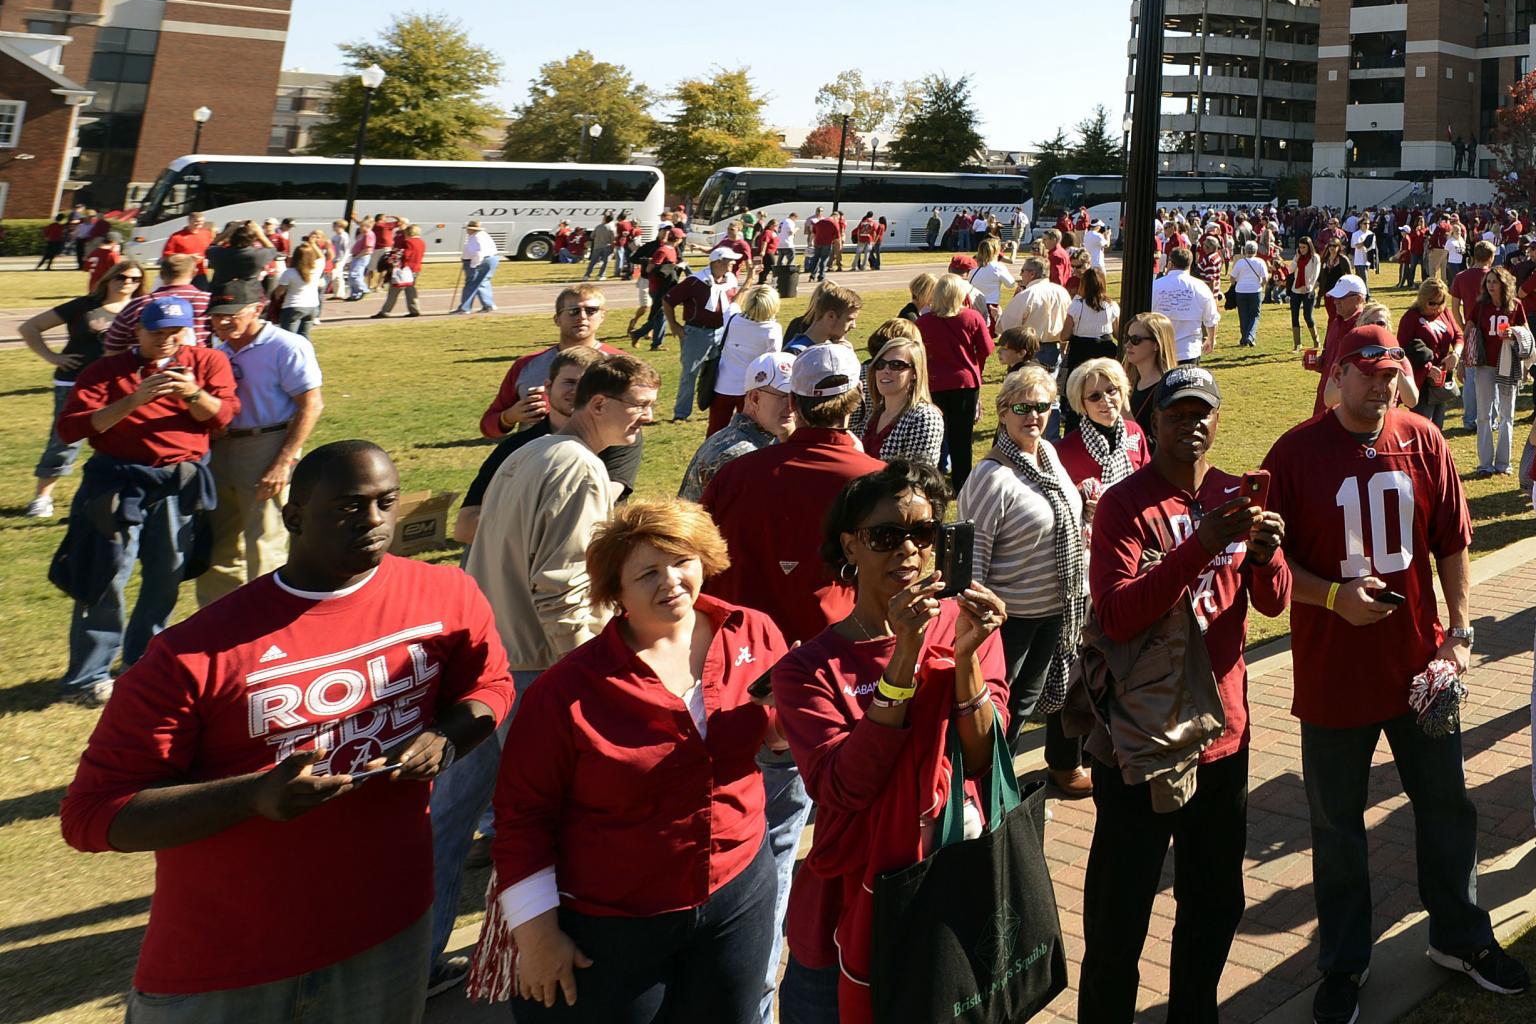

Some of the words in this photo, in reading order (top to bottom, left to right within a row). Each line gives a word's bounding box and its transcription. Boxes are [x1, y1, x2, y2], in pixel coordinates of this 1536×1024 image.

[1336, 470, 1415, 579] 10
[248, 642, 440, 739] ROLL
[264, 683, 430, 765] TIDE
